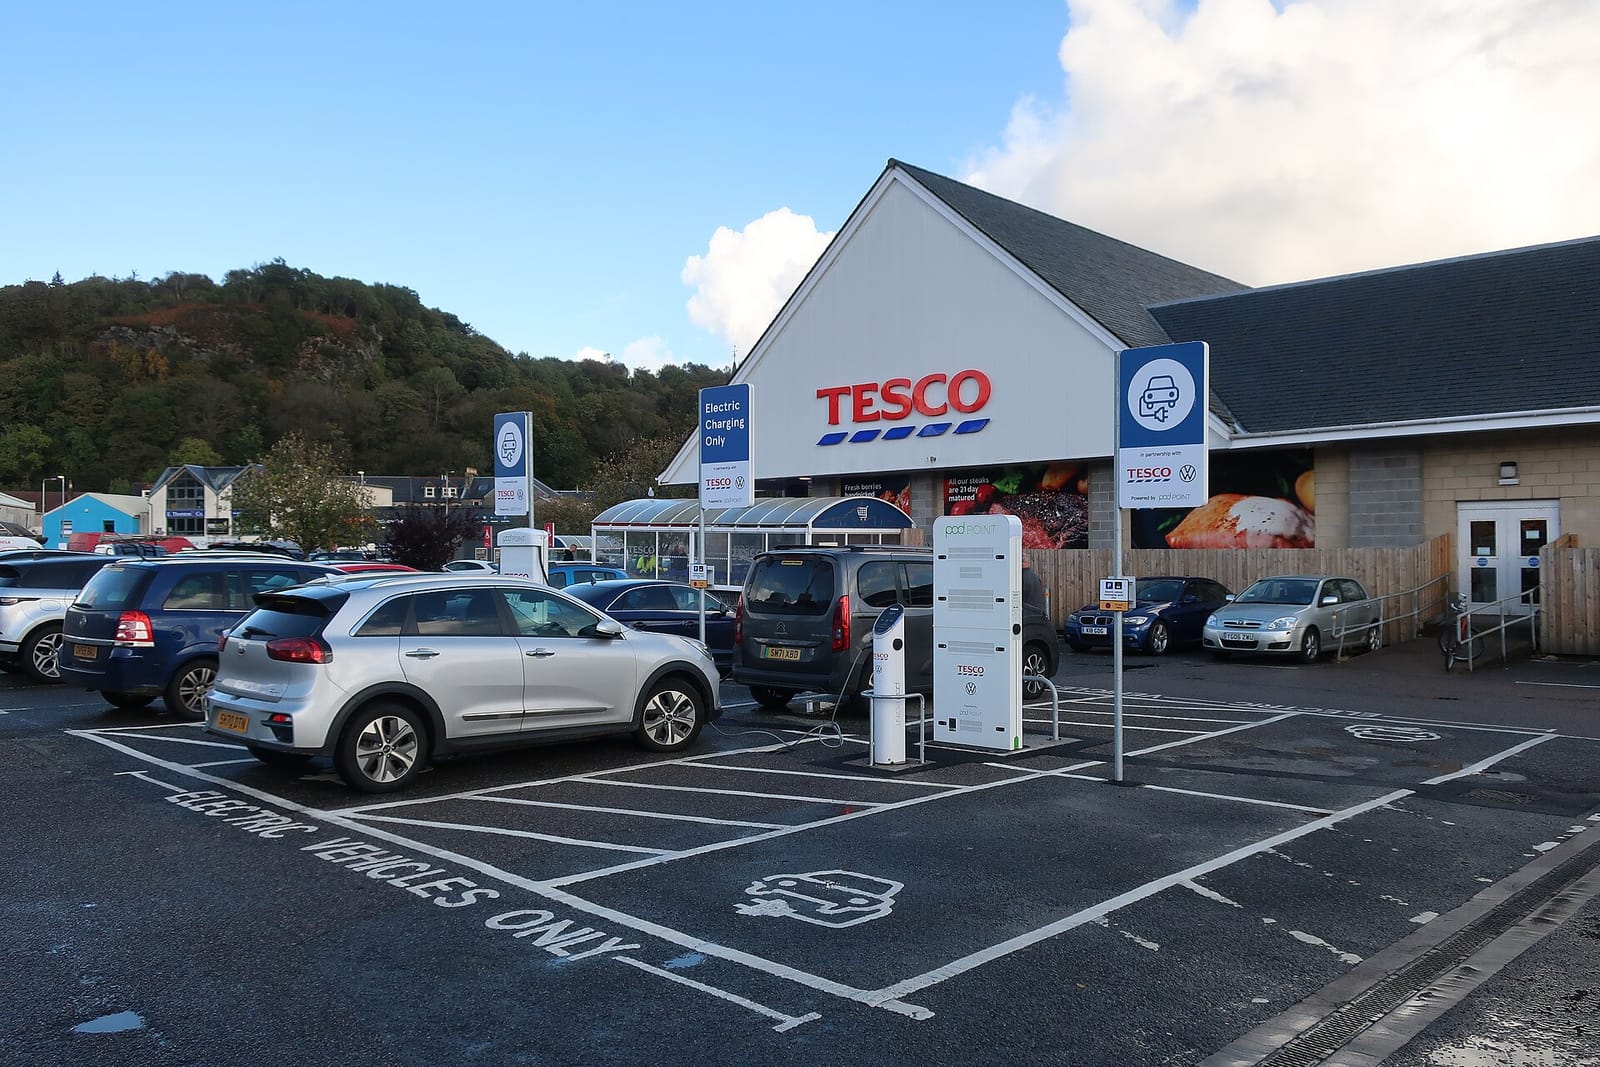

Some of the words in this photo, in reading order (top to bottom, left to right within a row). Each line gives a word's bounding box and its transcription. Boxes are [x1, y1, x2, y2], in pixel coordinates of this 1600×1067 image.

[816, 369, 992, 426] TESCO
[705, 400, 741, 414] Electric
[705, 417, 745, 430] Charging
[705, 435, 726, 447] Only
[1126, 467, 1171, 479] TESCO
[705, 478, 732, 487] TESCO
[948, 485, 959, 494] are
[967, 485, 979, 494] day
[948, 493, 976, 502] matured
[945, 520, 966, 539] pod
[628, 545, 655, 555] TESCO
[957, 665, 985, 674] TESCO
[164, 790, 319, 839] ELECTRIC
[299, 837, 500, 908] VEHICLES
[484, 909, 641, 962] ONLY
